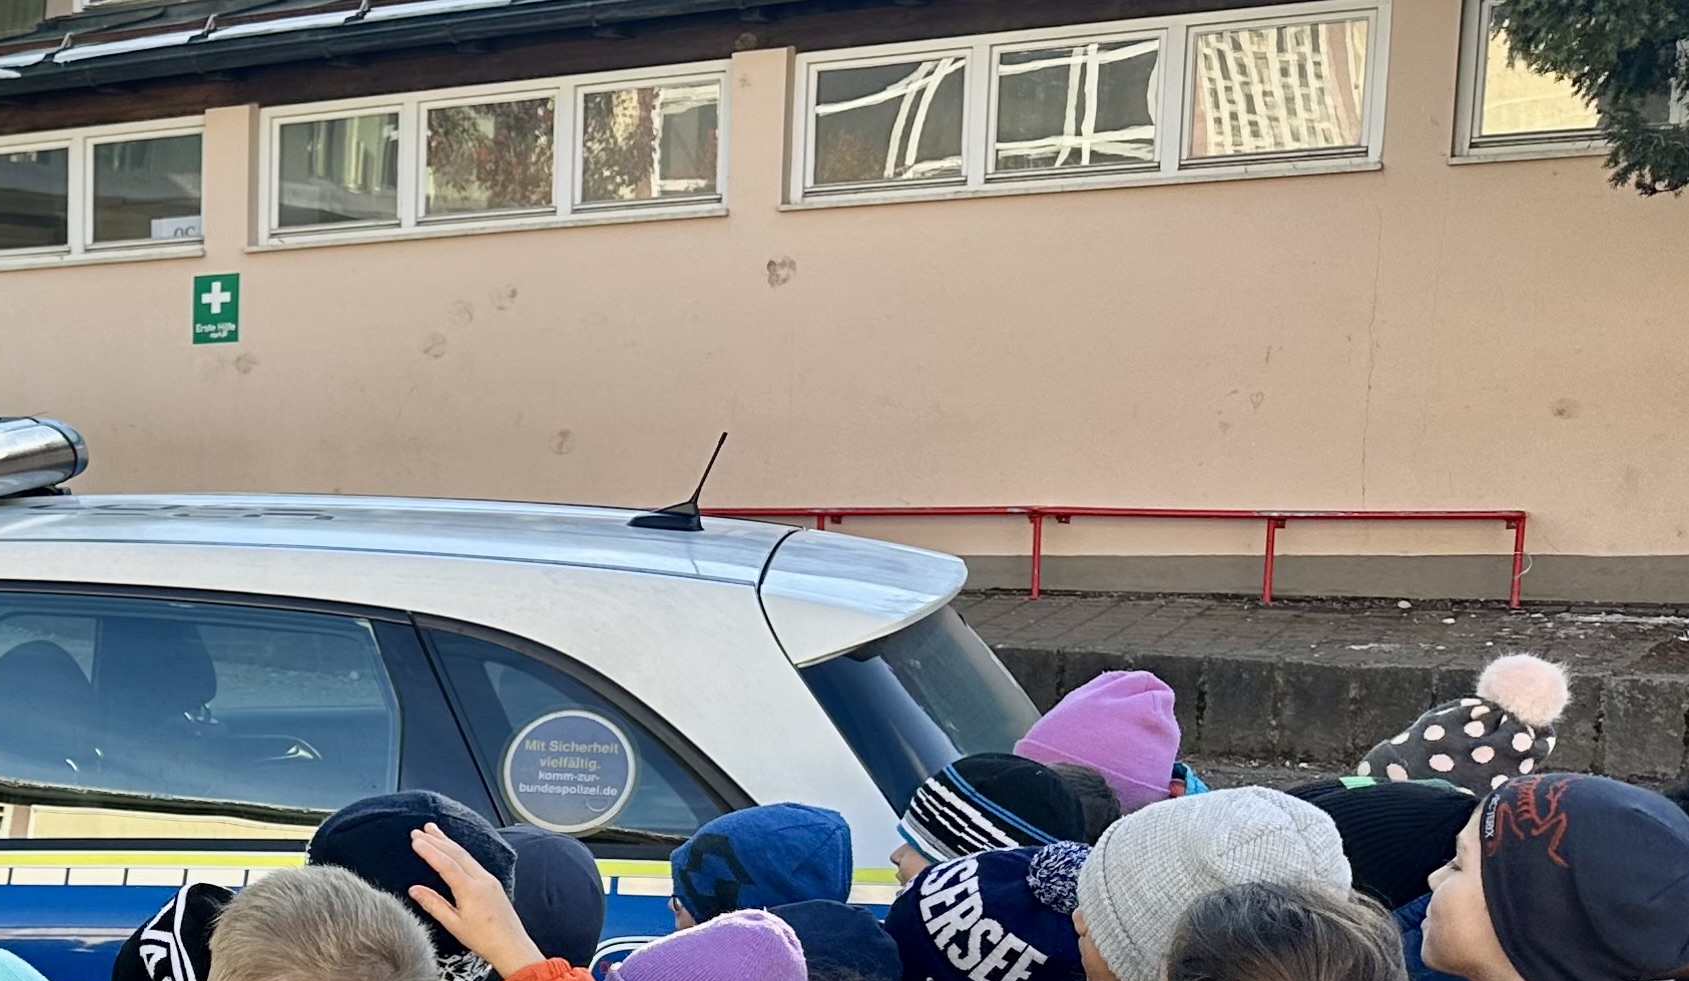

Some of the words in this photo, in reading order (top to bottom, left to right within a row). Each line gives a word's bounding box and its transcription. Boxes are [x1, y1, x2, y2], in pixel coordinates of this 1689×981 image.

[525, 740, 546, 752] Mit
[549, 741, 619, 755] Sicherheit
[539, 758, 601, 772] vielfältig.
[538, 770, 600, 783] komm-zur-
[518, 782, 618, 797] bundespolizei.de
